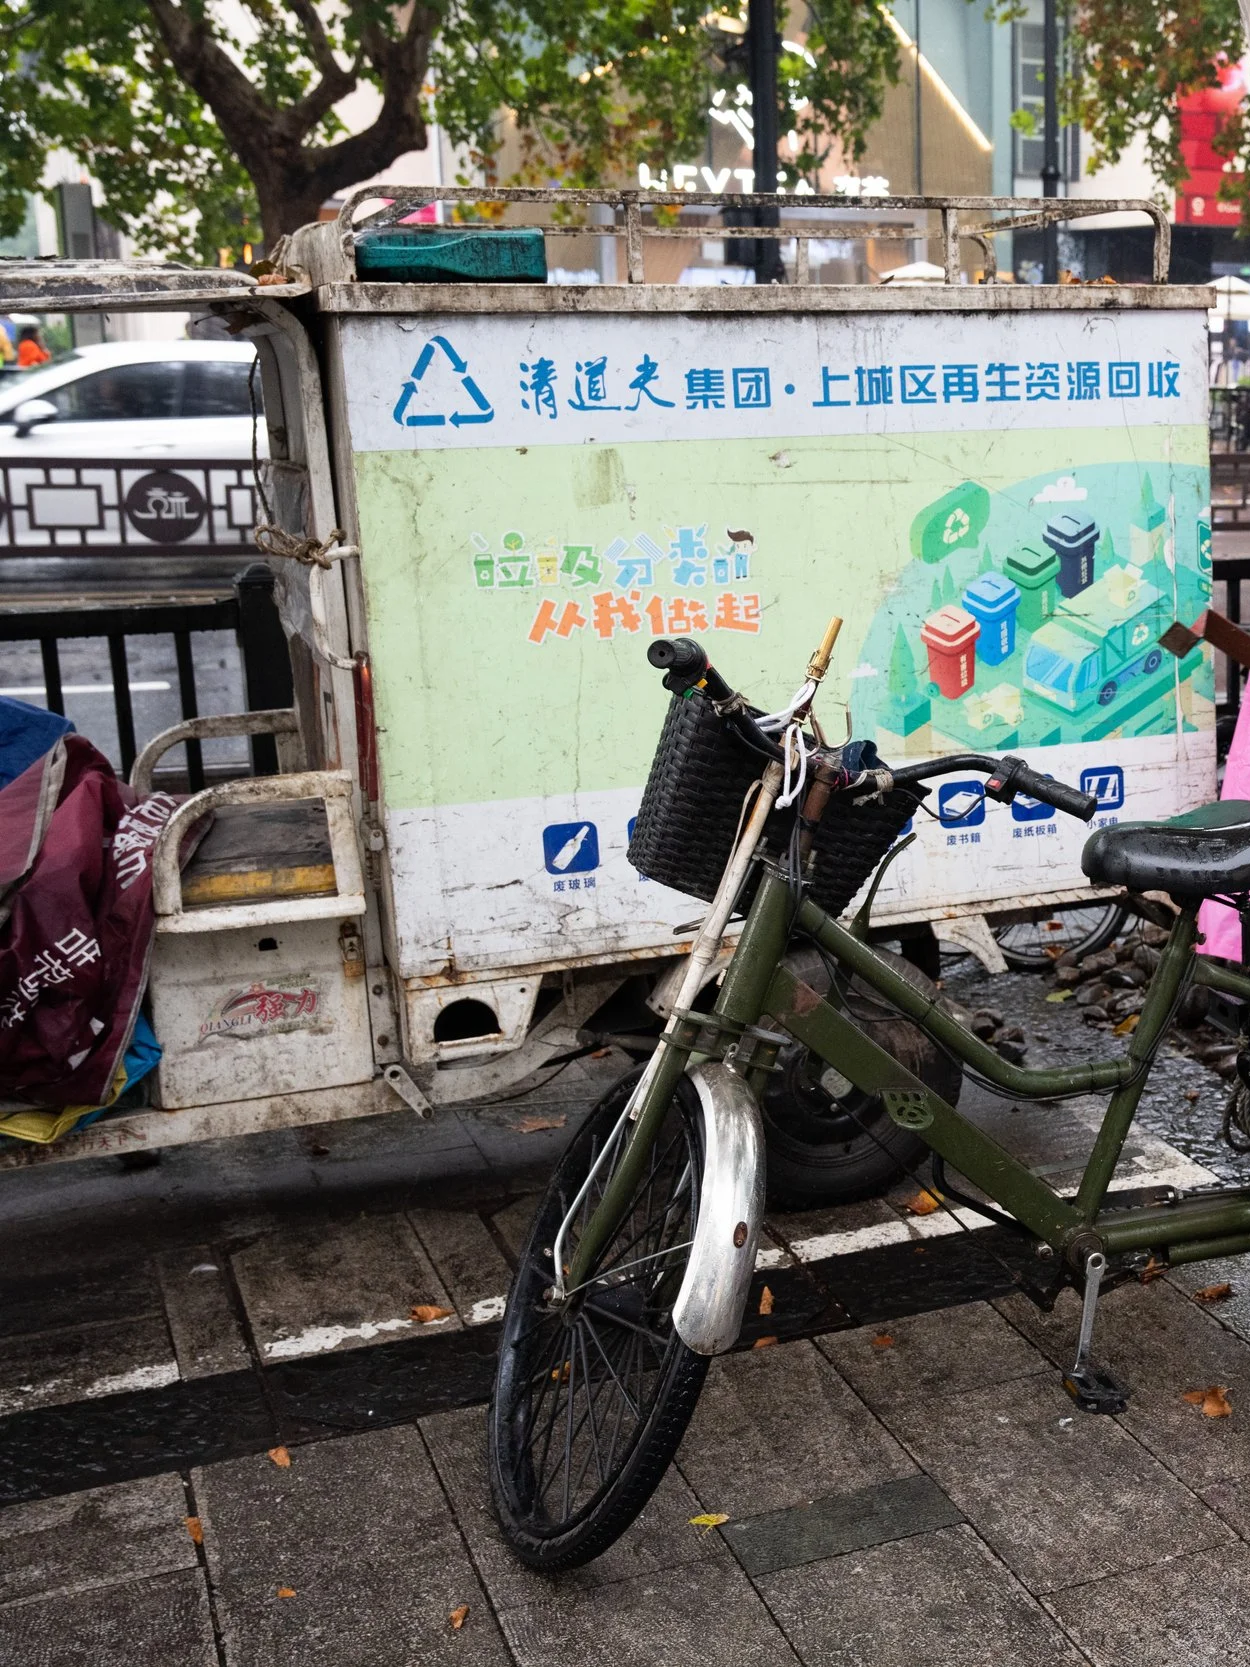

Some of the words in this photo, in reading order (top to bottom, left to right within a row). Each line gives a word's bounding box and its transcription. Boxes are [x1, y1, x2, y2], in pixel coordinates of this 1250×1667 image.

[527, 589, 763, 645] 从我做起
[1012, 823, 1057, 838] 废纸板箱
[946, 832, 981, 846] 废书籍
[553, 877, 597, 893] 废玻璃
[255, 987, 318, 1024] 强力
